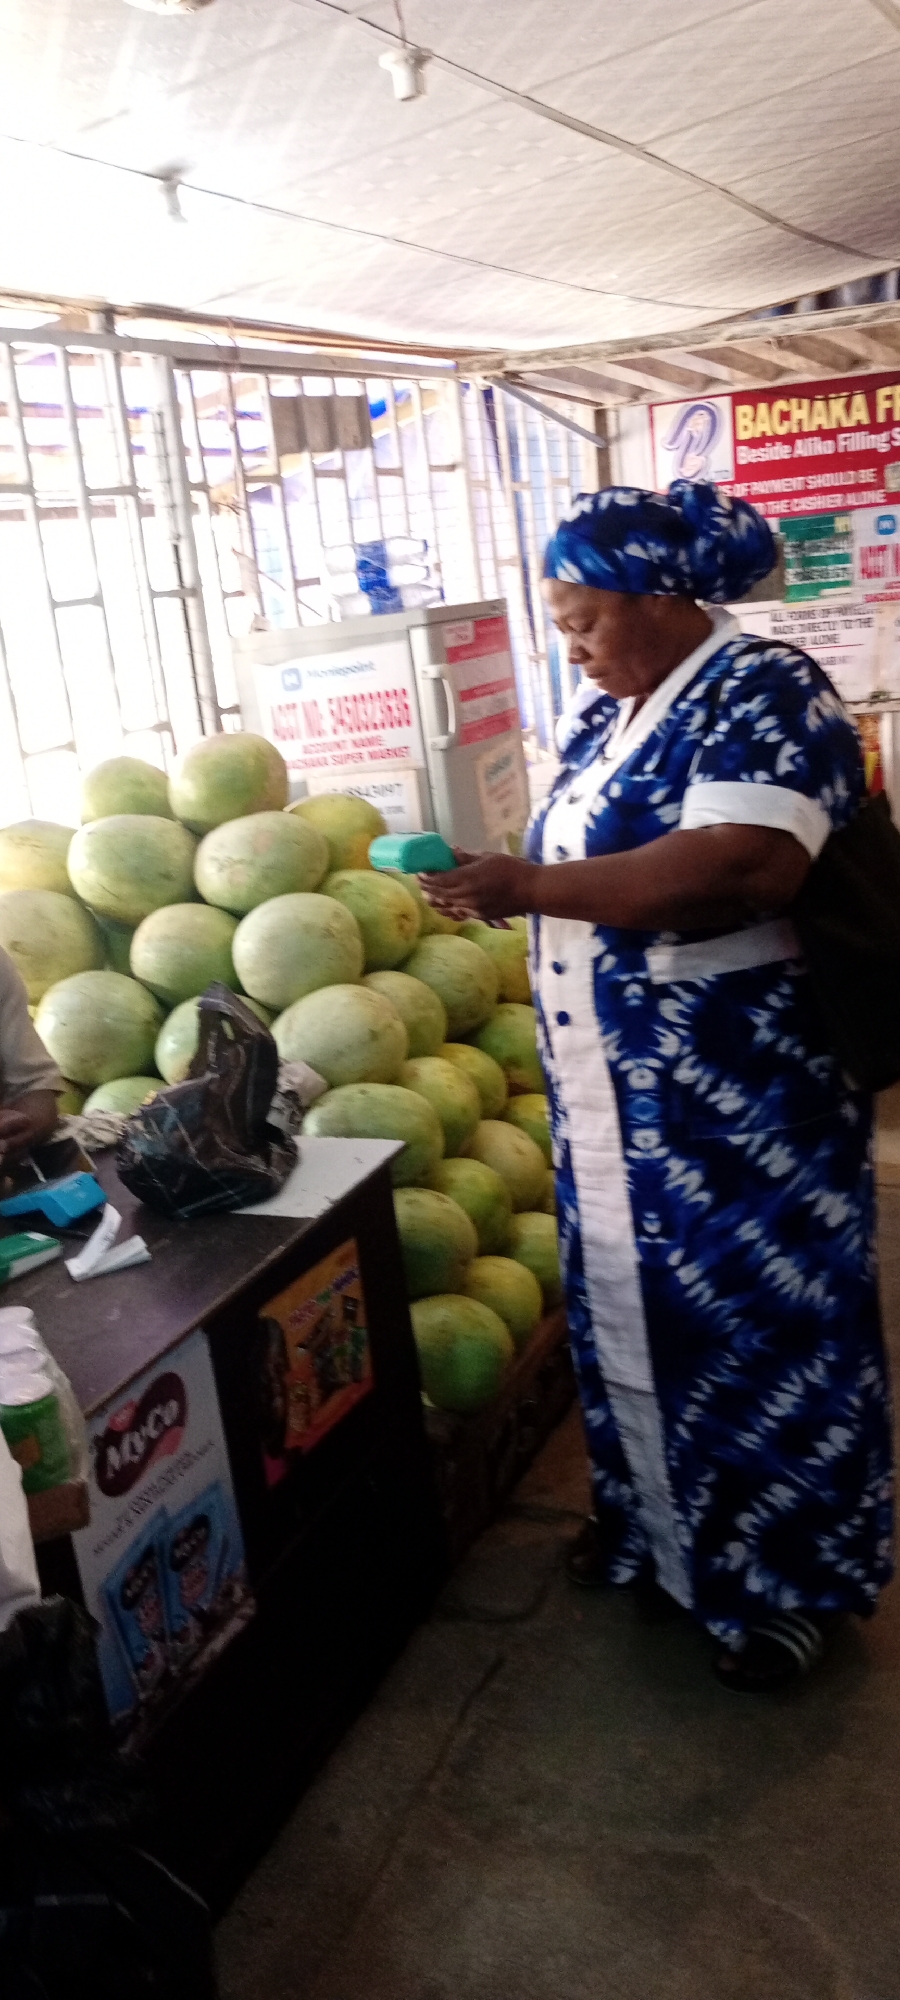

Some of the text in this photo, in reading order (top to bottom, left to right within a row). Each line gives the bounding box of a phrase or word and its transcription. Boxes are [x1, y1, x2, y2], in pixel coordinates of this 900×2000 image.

[735, 390, 871, 440] BACHAKA
[736, 443, 792, 465] Beside
[837, 430, 891, 453] Filling
[751, 477, 806, 496] PAYMENT
[806, 471, 854, 490] SHOULD
[857, 468, 878, 484] BE
[768, 498, 791, 514] THE
[791, 493, 844, 512] CASHIER
[846, 489, 887, 506] ALONE
[302, 740, 348, 754] ACCOUNT
[330, 752, 364, 766] SUPER
[368, 746, 410, 760] MARKET
